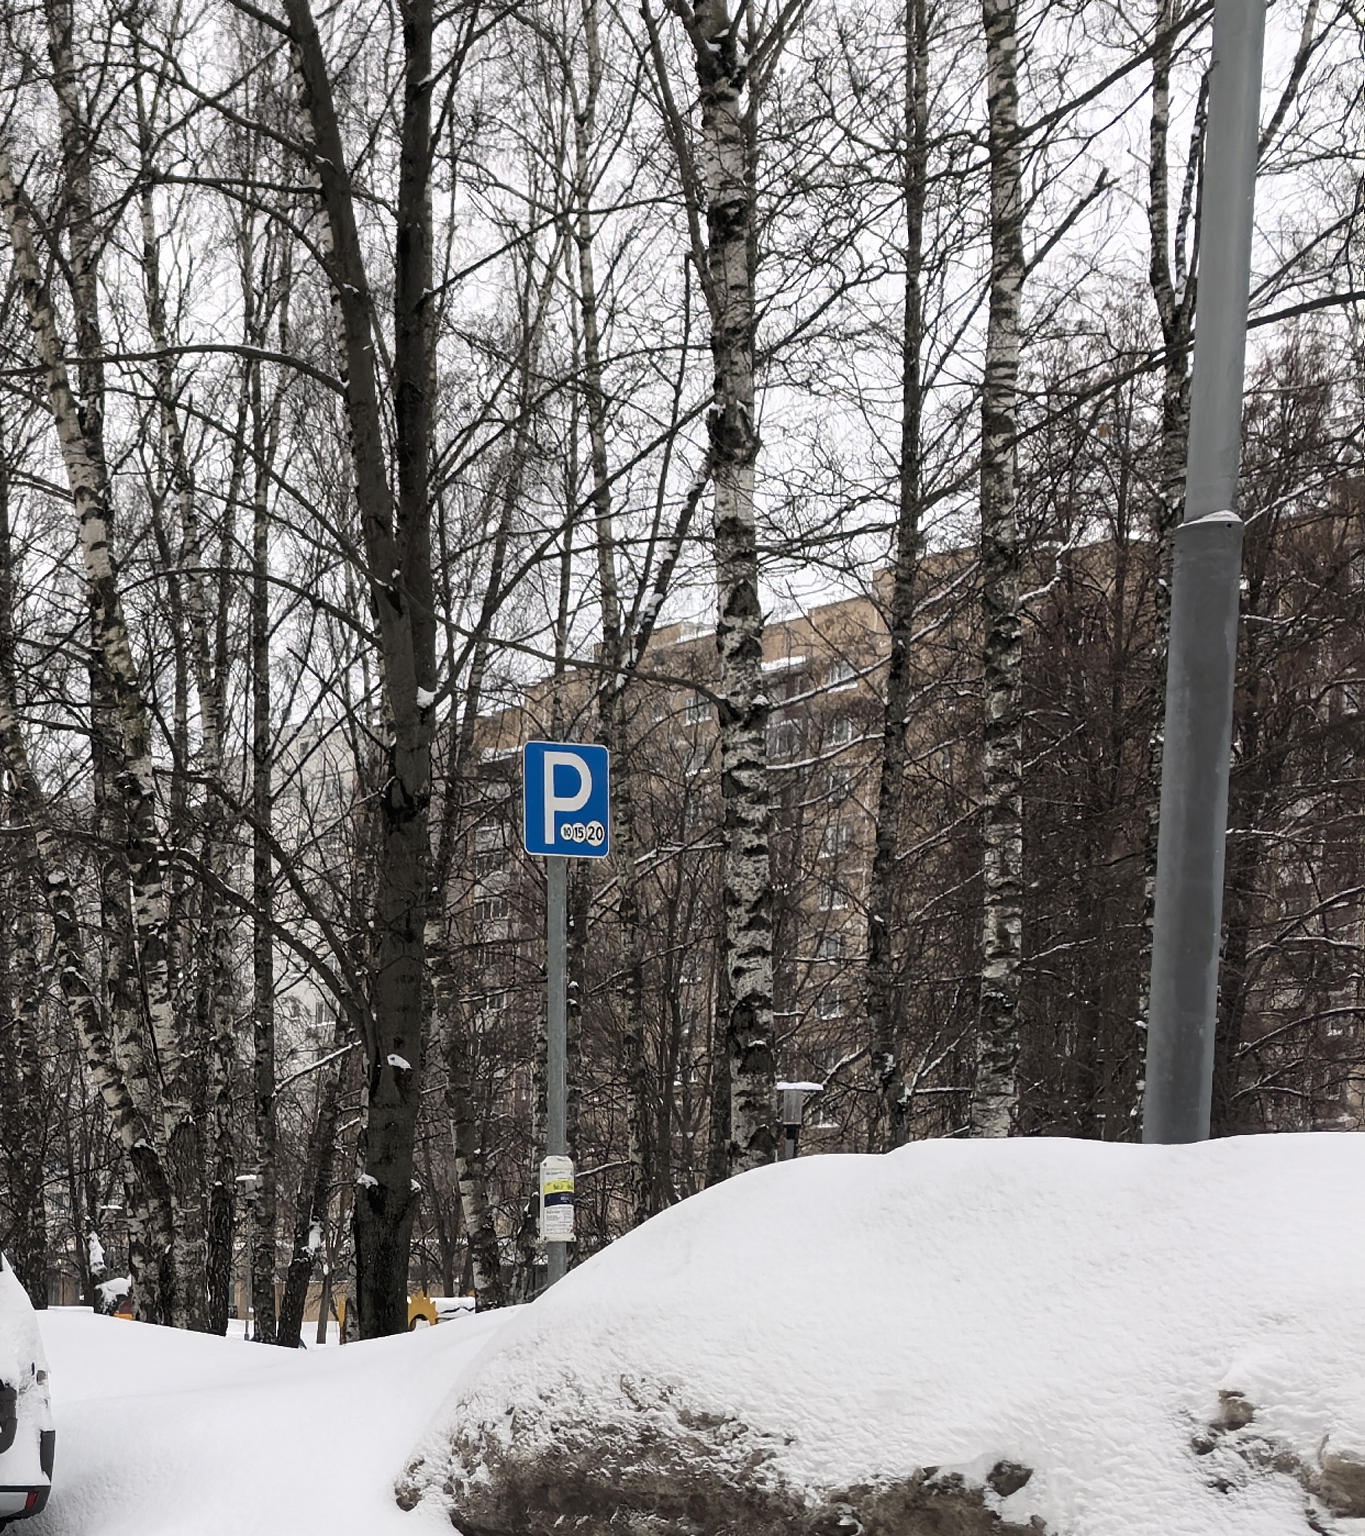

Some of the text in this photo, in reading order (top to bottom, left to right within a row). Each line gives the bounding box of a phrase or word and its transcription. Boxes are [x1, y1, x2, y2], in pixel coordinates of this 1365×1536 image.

[544, 751, 593, 845] P
[574, 827, 584, 839] 15
[588, 826, 603, 841] 20
